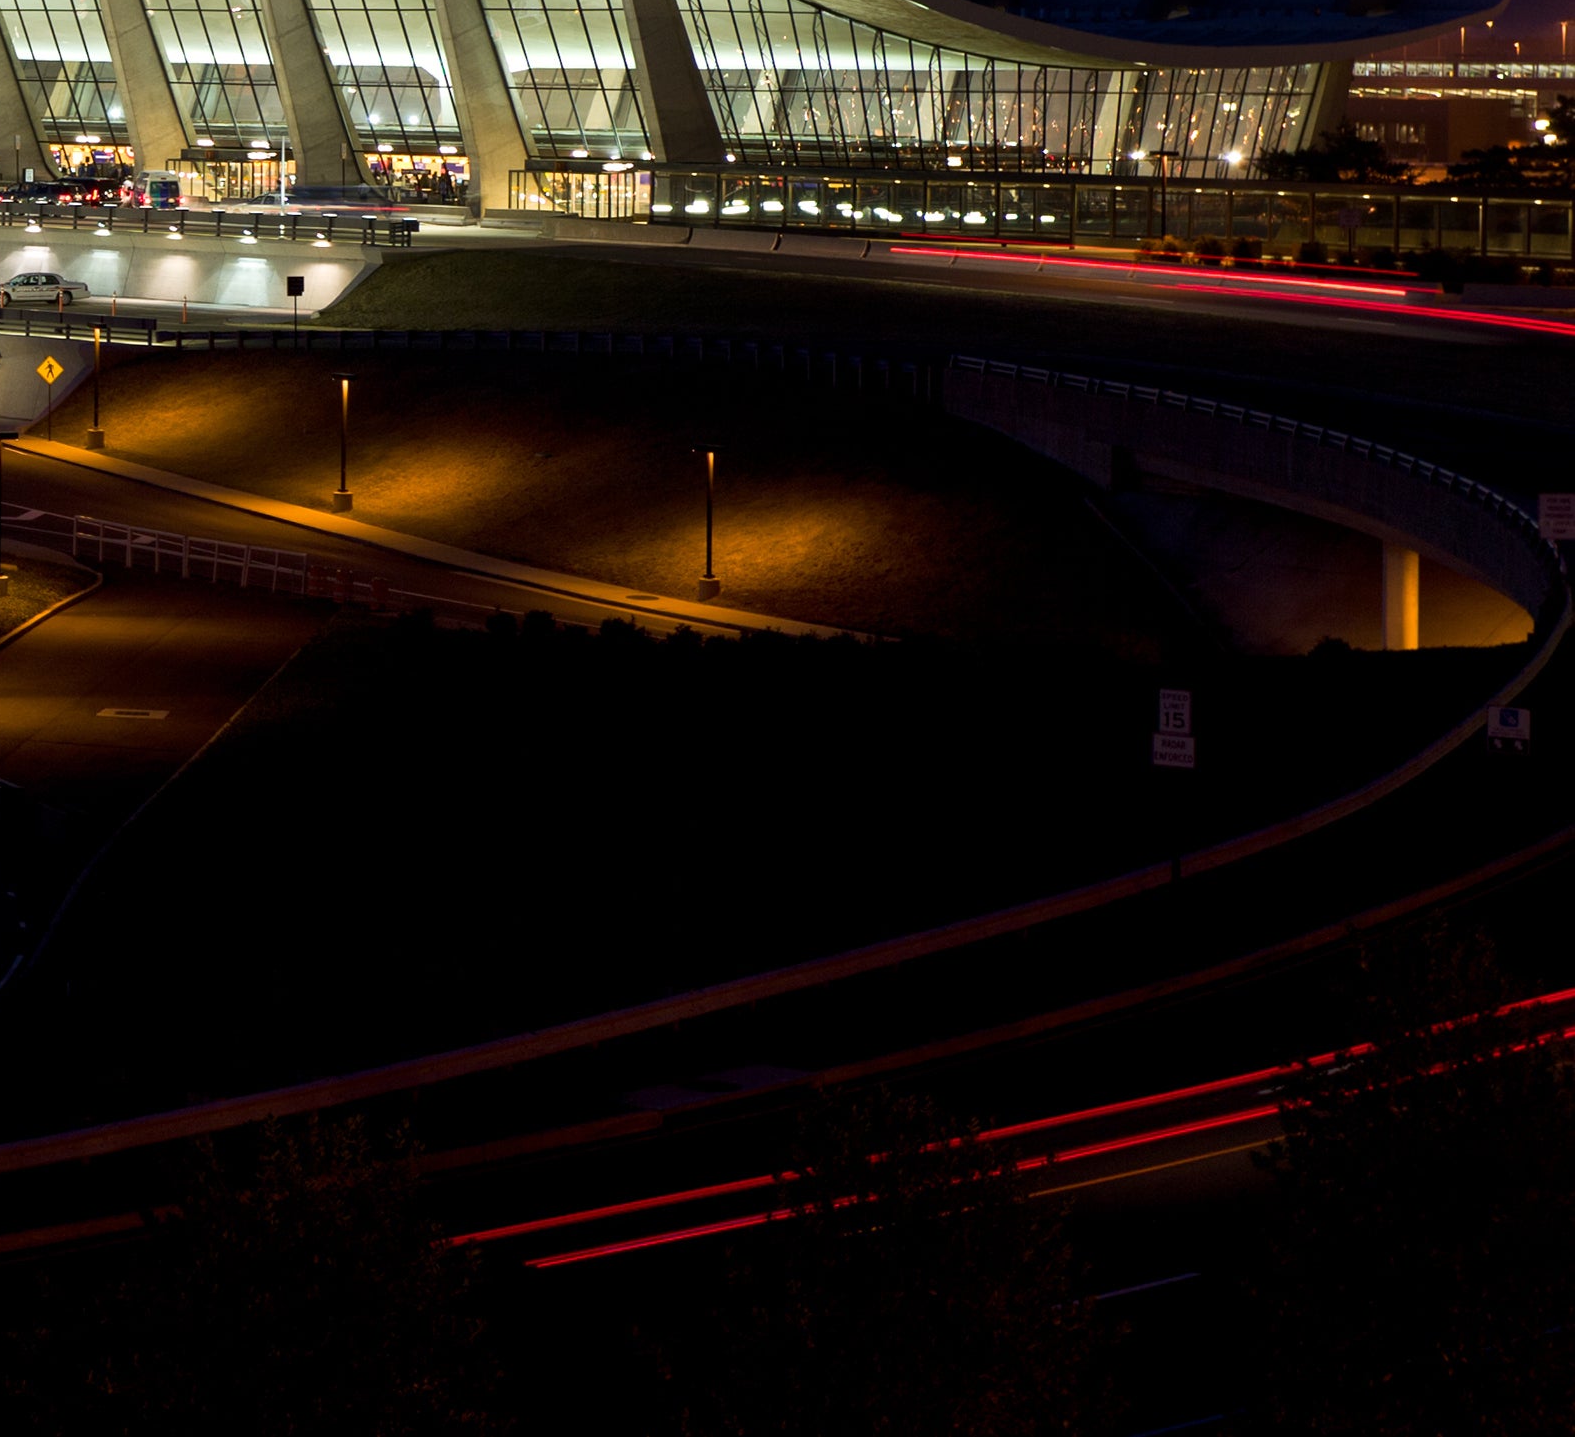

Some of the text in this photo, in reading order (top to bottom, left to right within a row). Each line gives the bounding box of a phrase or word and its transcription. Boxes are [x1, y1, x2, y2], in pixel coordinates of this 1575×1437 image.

[1162, 692, 1188, 702] SPEED
[1163, 702, 1185, 710] LIMIT
[1164, 712, 1185, 728] 15
[1161, 739, 1186, 750] RADAR
[1154, 751, 1194, 764] ENFORCED
